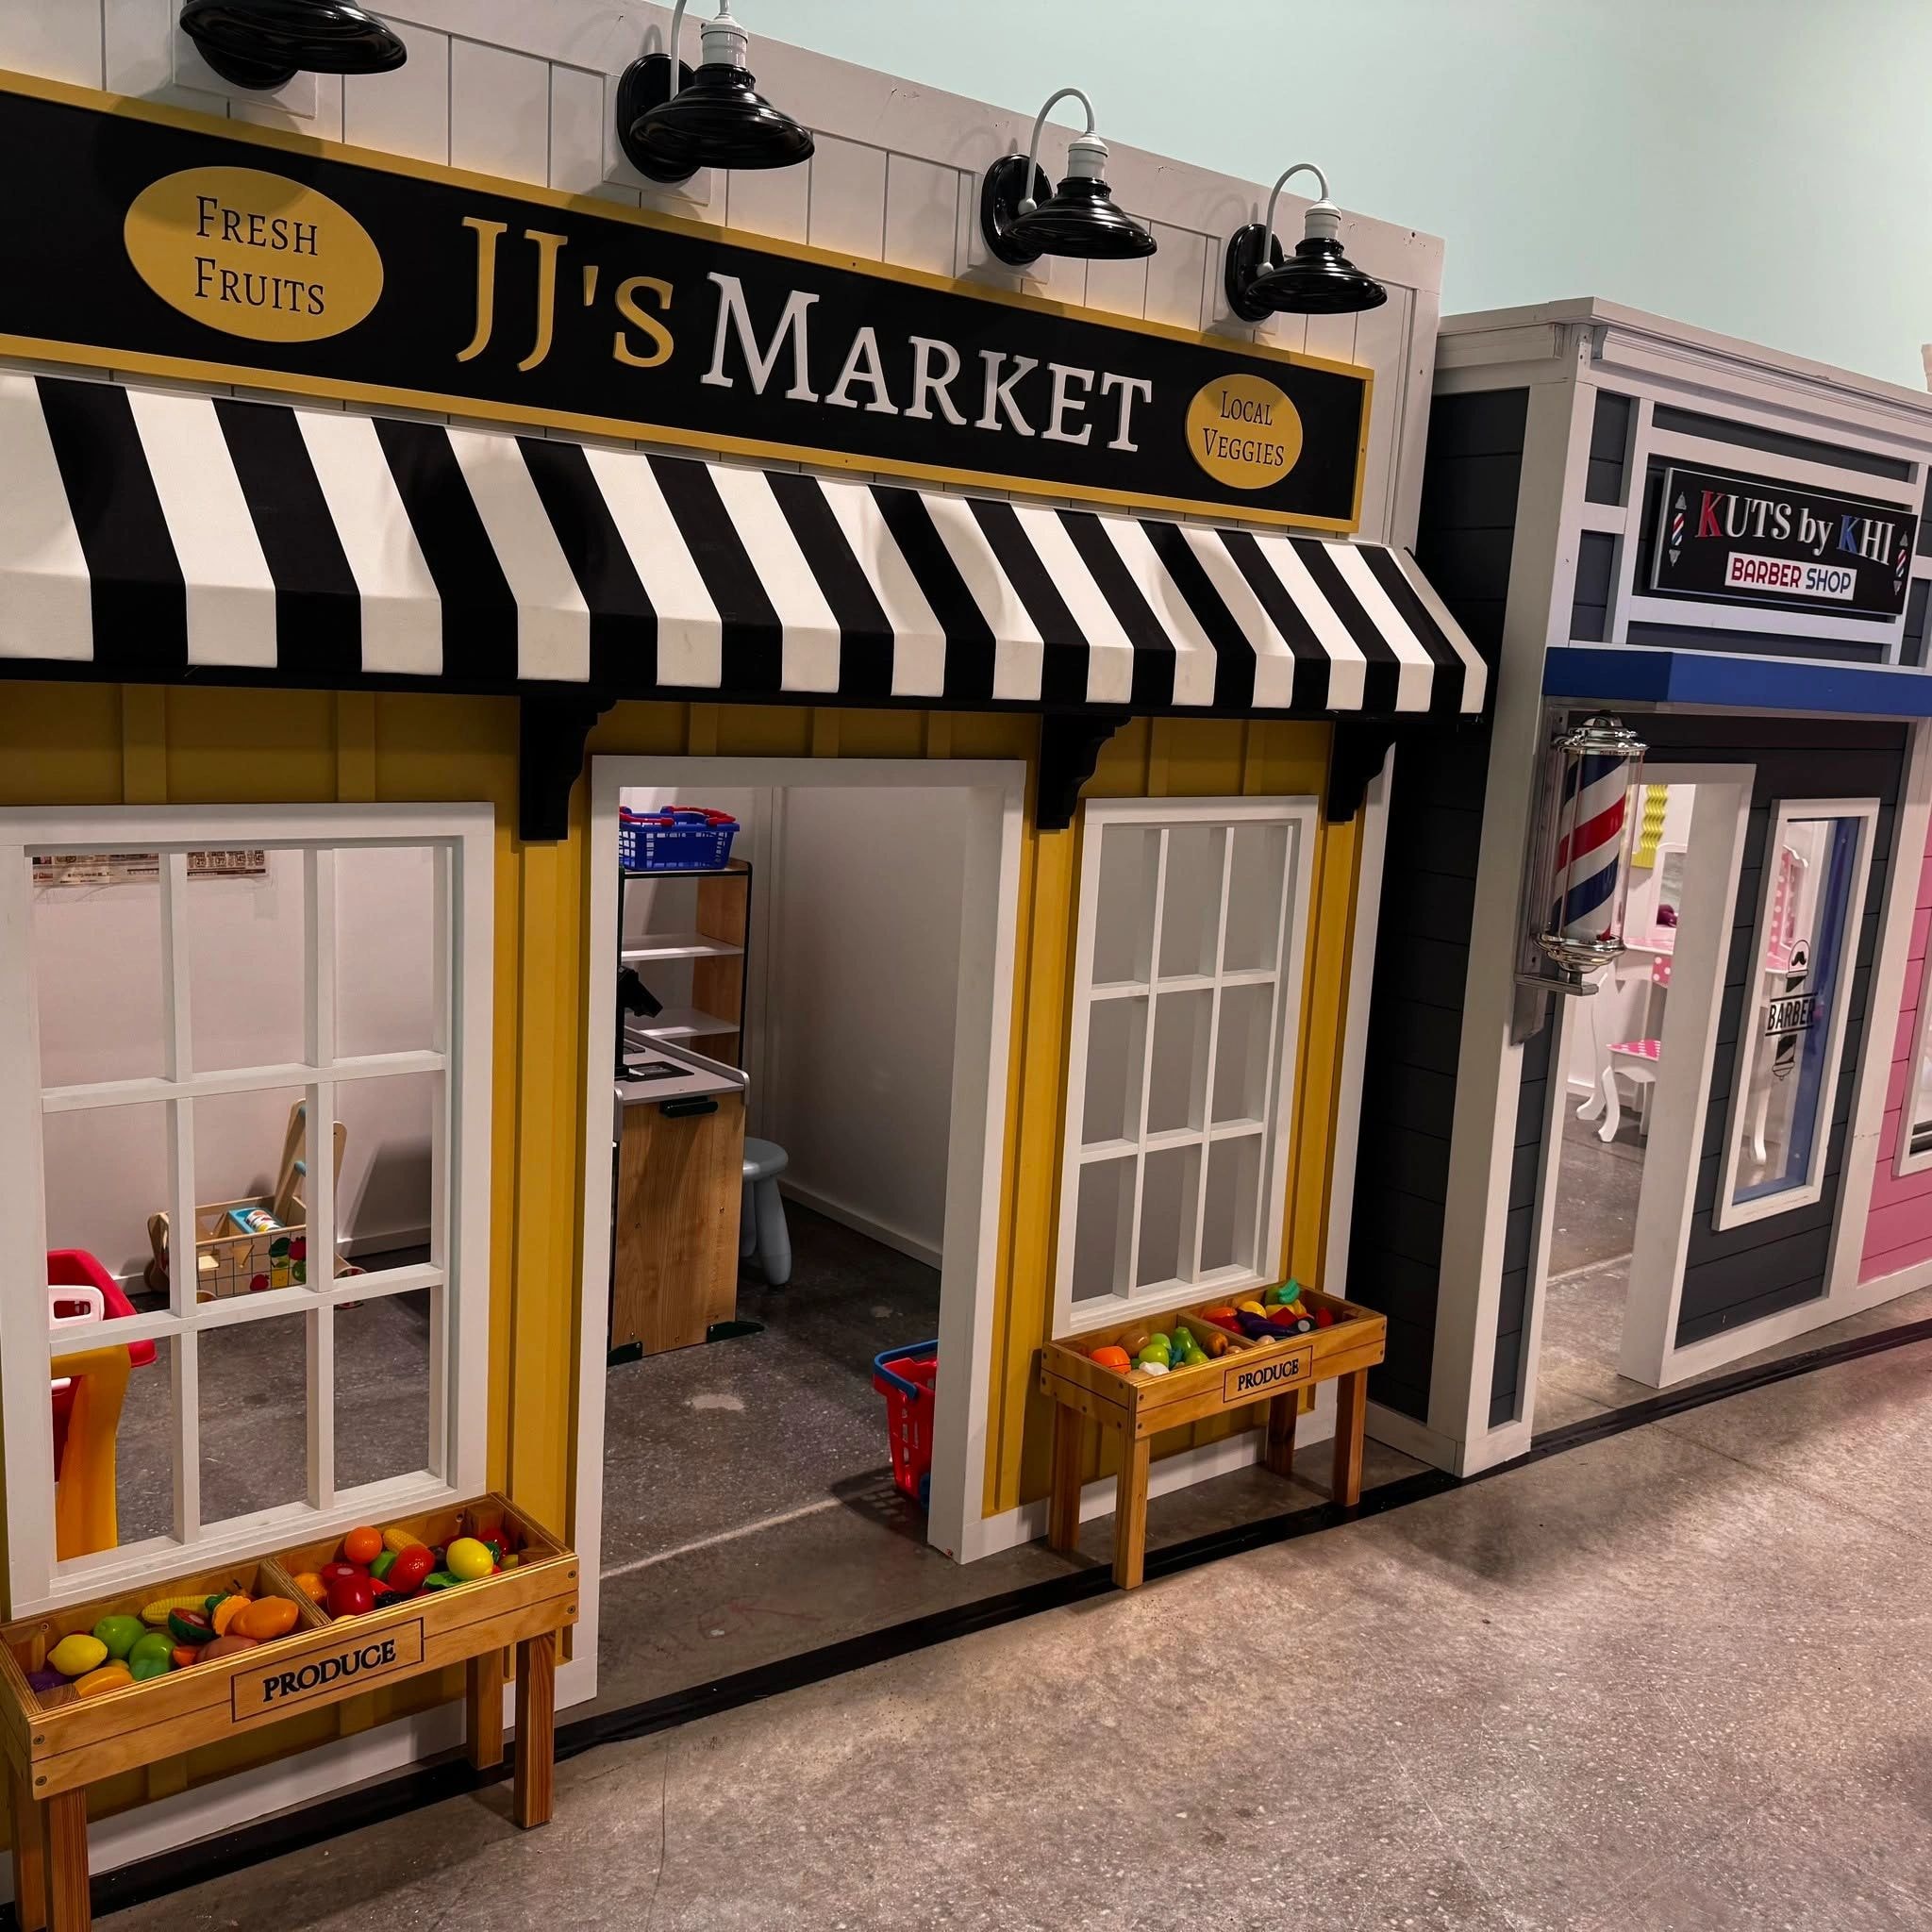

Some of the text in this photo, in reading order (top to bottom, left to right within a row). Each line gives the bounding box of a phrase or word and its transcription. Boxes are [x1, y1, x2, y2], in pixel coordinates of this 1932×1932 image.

[195, 195, 319, 257] FRESH
[193, 256, 325, 316] FRUITS
[700, 271, 1153, 453] MARKET
[1220, 390, 1274, 426] LOCAL
[1202, 427, 1285, 467] VEGGIES
[1694, 490, 1895, 566] KUTS by KHI
[1730, 557, 1851, 594] BARBER SHOP
[1767, 996, 1816, 1030] BARBER
[1237, 1357, 1299, 1391] PRODUCE
[262, 1639, 397, 1703] PRODUCE
